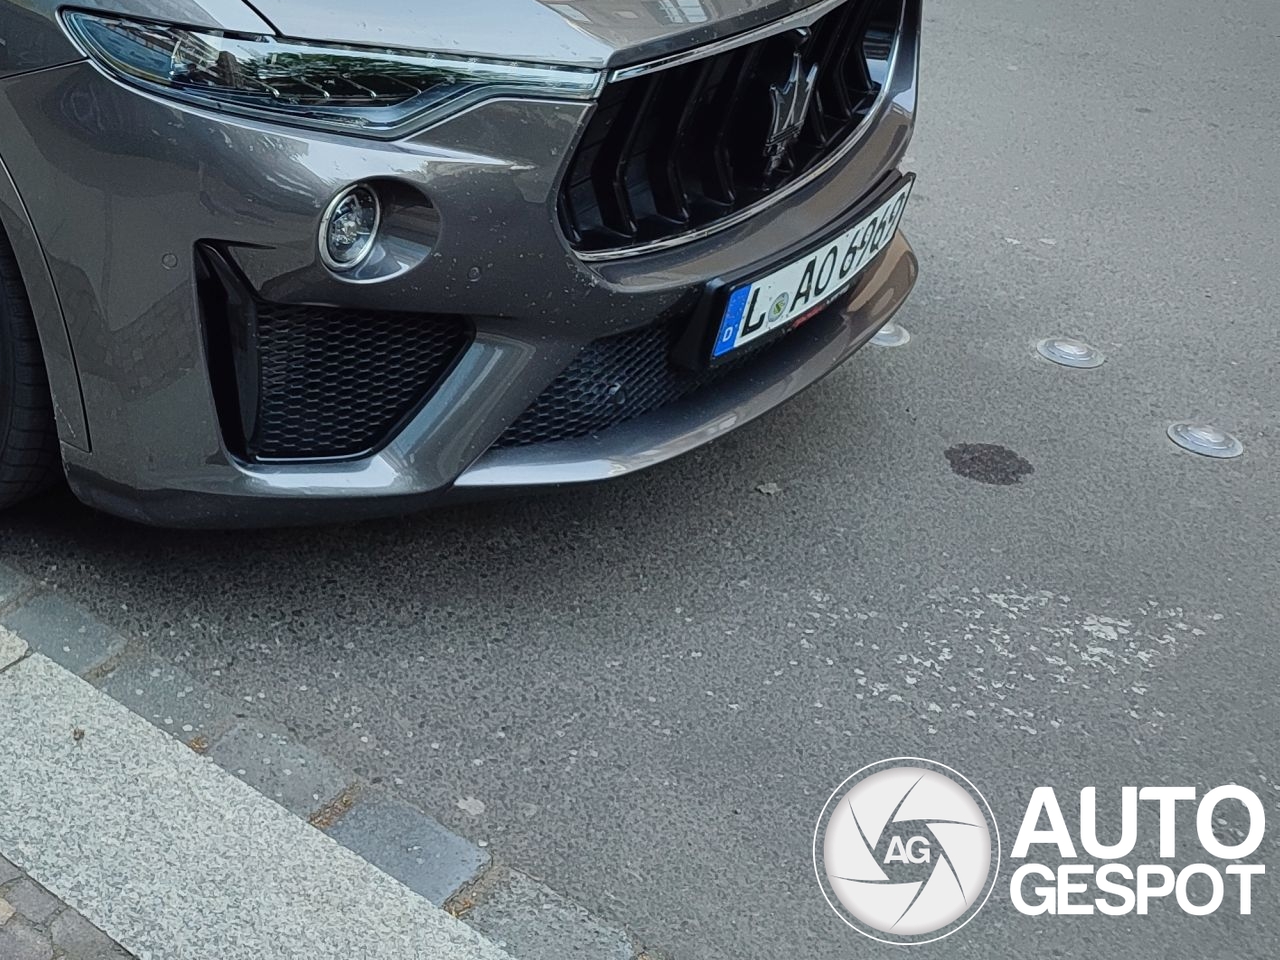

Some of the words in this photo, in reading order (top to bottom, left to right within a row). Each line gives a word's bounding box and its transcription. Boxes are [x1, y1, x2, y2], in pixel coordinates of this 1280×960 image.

[740, 286, 766, 338] L
[788, 245, 838, 313] AO
[722, 326, 734, 342] D
